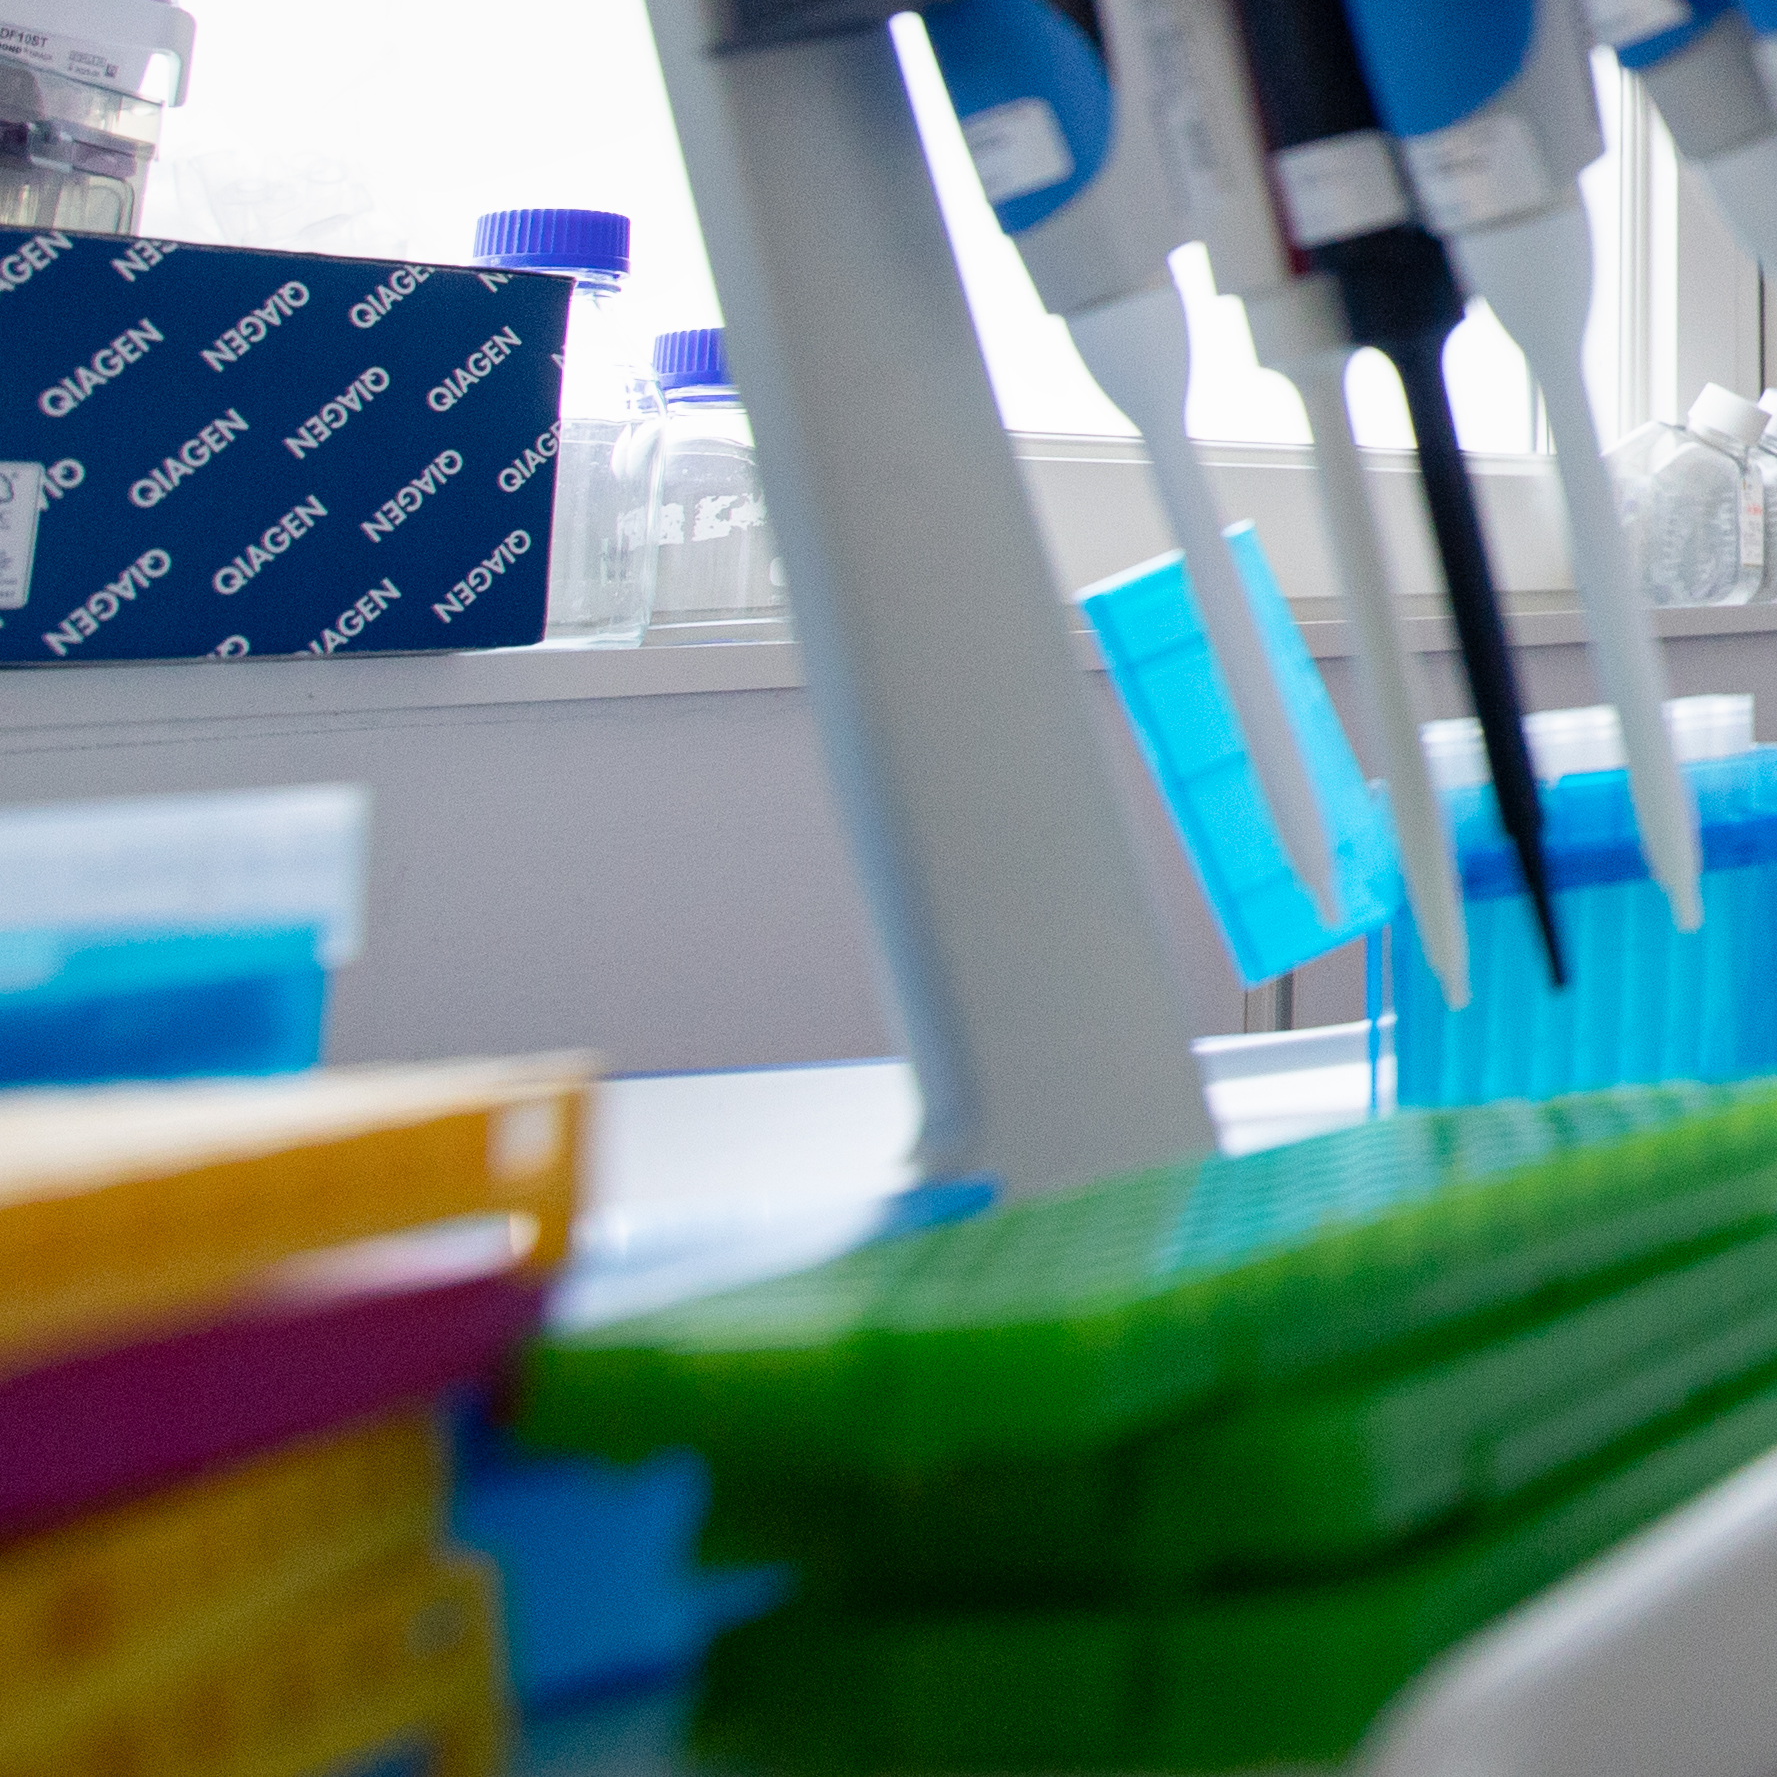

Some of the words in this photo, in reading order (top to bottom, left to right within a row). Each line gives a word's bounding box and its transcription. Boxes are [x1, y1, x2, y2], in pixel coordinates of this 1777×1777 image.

[38, 318, 165, 418] QIAGEN
[200, 281, 310, 372] QIAGEN
[427, 325, 522, 413] QIAGEN
[128, 407, 249, 509] QIAGEN
[283, 366, 390, 459] QIAGEN
[359, 449, 464, 543] QIAGEN
[212, 494, 328, 596] QIAGEN
[431, 529, 532, 624] QIAGEN
[41, 548, 172, 657] QIAGEN
